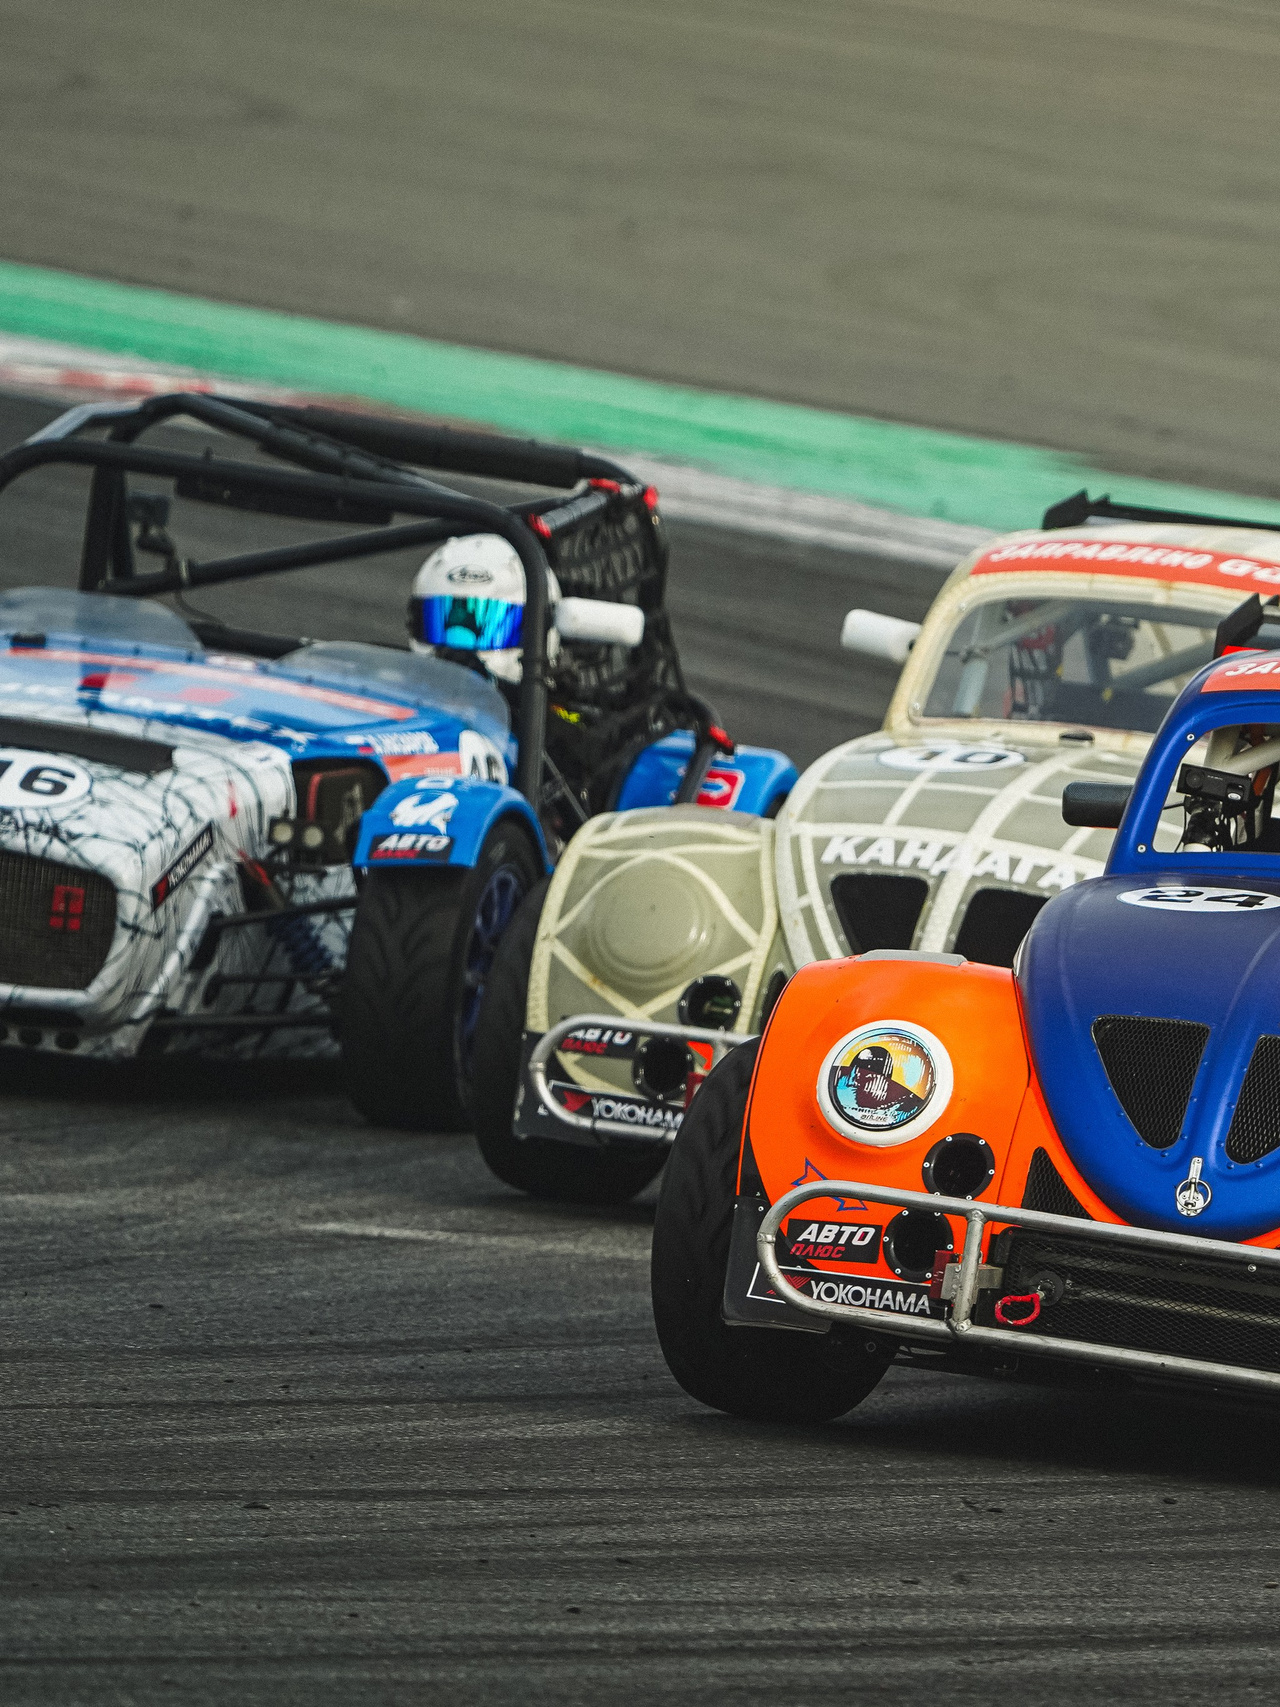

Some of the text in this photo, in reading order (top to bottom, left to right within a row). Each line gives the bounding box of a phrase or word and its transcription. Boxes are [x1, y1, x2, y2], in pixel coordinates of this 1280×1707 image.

[990, 542, 1213, 570] ЗАПРАВЛЕНО
[378, 833, 451, 852] АВТО
[821, 834, 1106, 891] КАНДАГА
[1138, 889, 1270, 908] 24
[591, 1097, 686, 1130] YOKOHAM
[796, 1223, 876, 1247] АВТО
[790, 1243, 846, 1260] ПЛЮС
[810, 1280, 932, 1316] YOKOHAMA
